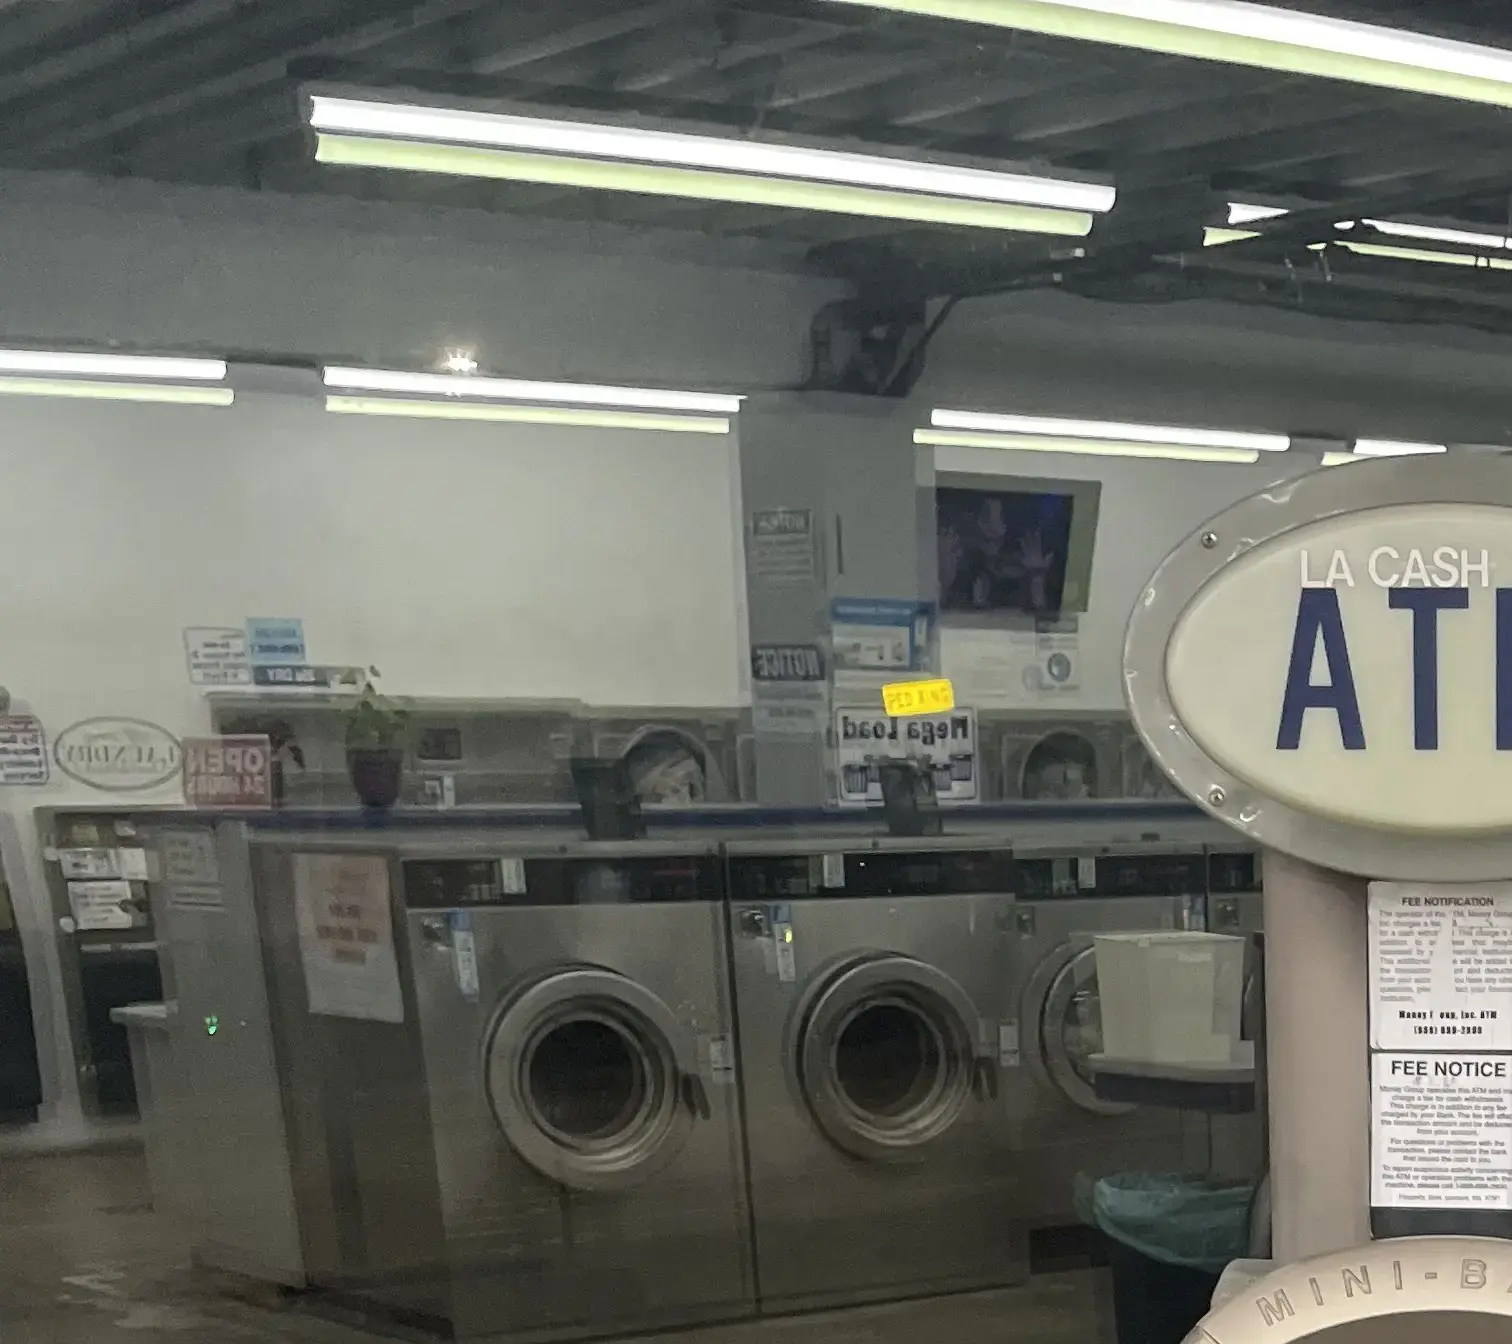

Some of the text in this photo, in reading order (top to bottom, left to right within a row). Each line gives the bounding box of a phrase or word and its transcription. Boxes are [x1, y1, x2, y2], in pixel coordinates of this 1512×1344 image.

[1301, 546, 1490, 588] LA CASH
[1402, 896, 1494, 907] FEE NOTIFICATION
[1391, 1060, 1507, 1078] FEE NOTICE
